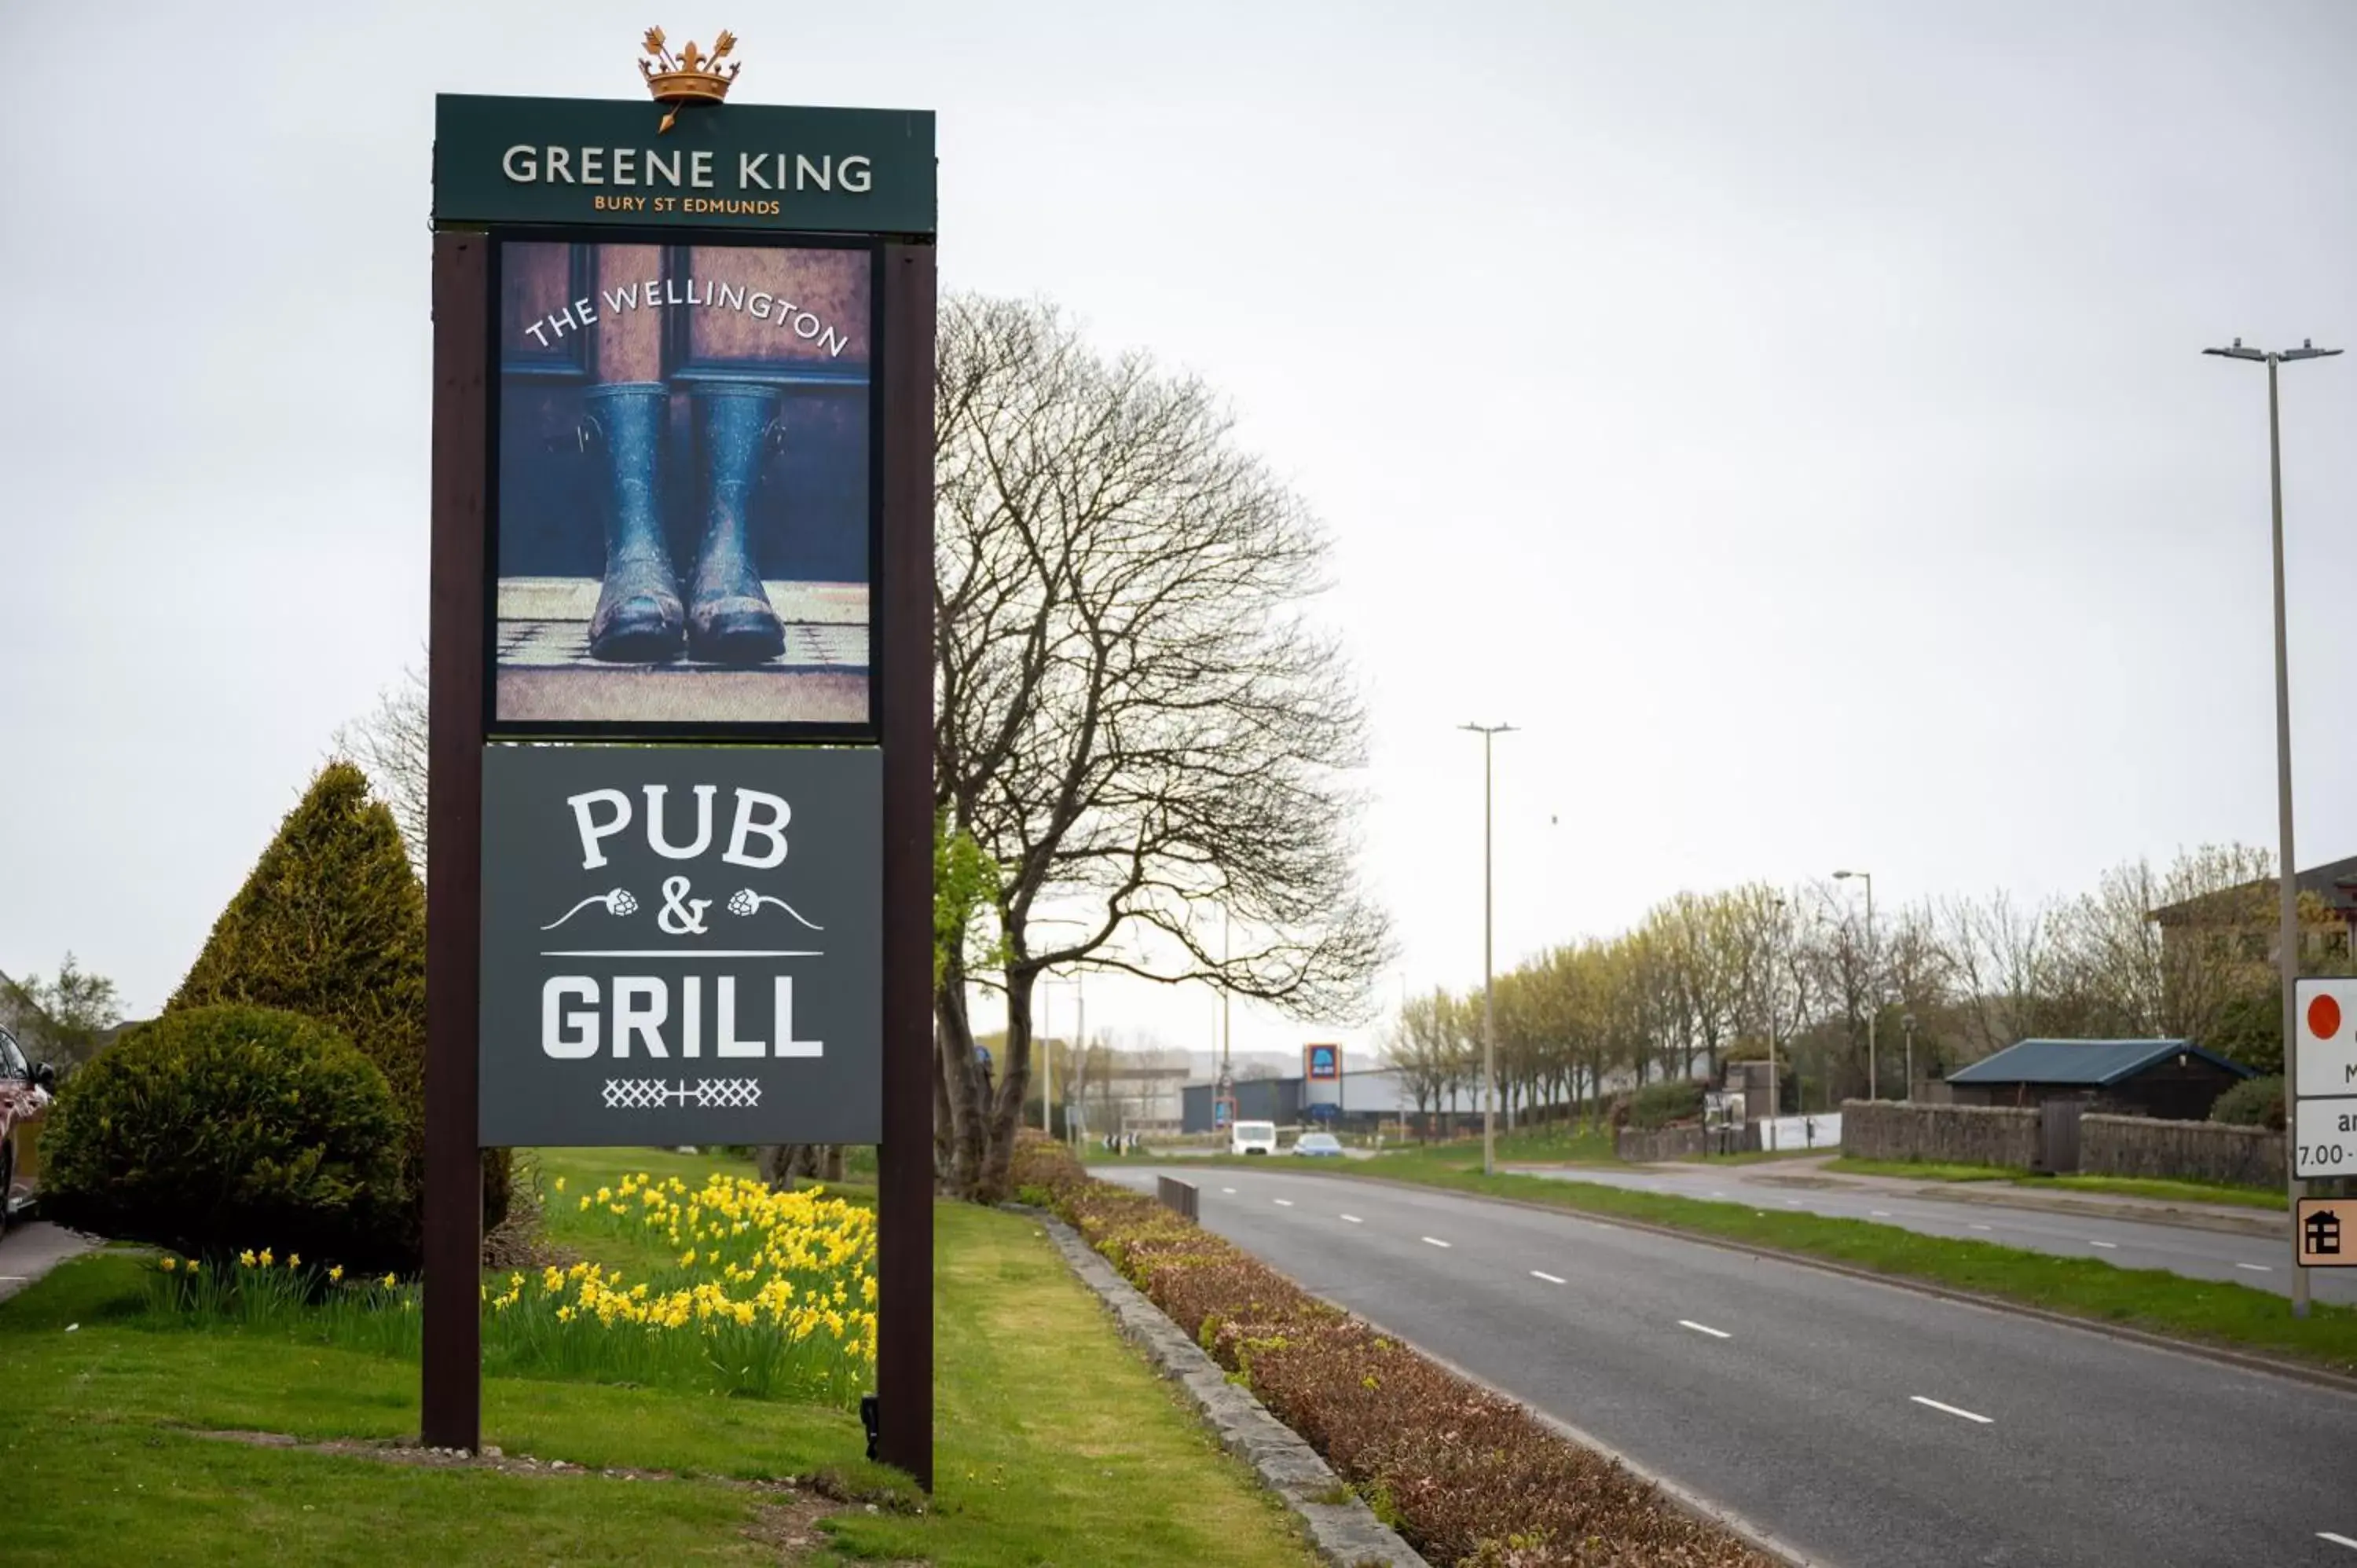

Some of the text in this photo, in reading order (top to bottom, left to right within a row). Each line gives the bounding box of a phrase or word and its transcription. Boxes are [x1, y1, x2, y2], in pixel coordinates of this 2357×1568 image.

[502, 145, 872, 192] GREENE KING
[594, 196, 781, 214] BURY ST EDMUNDS
[525, 279, 849, 357] THE WELLINGTON
[566, 784, 792, 870] PUB
[657, 875, 713, 935] &
[541, 975, 824, 1059] GRILL
[2298, 1145, 2343, 1166] 7.00
